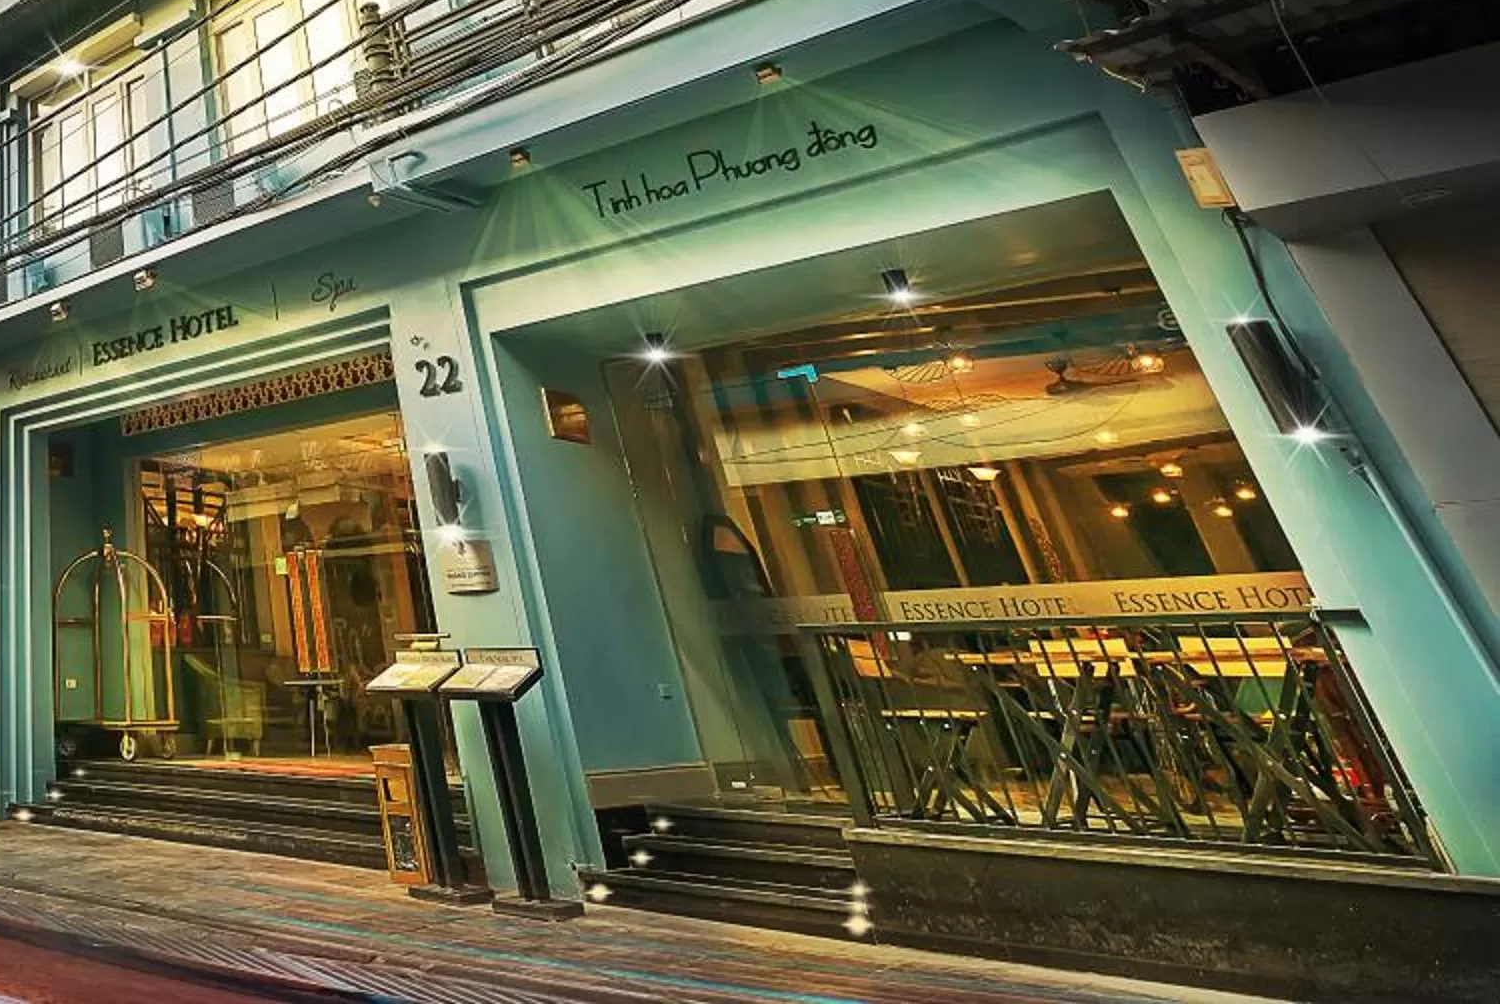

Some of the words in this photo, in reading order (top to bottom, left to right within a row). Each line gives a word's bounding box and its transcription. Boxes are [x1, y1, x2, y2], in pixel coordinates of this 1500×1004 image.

[582, 179, 642, 218] Tinh
[640, 172, 689, 204] hoa
[311, 271, 357, 313] Spa
[92, 325, 165, 367] ESSENCE
[169, 305, 239, 343] HOTEL
[415, 355, 463, 398] 22
[900, 600, 995, 621] ESSENCE
[1111, 591, 1232, 614] ESSENCE
